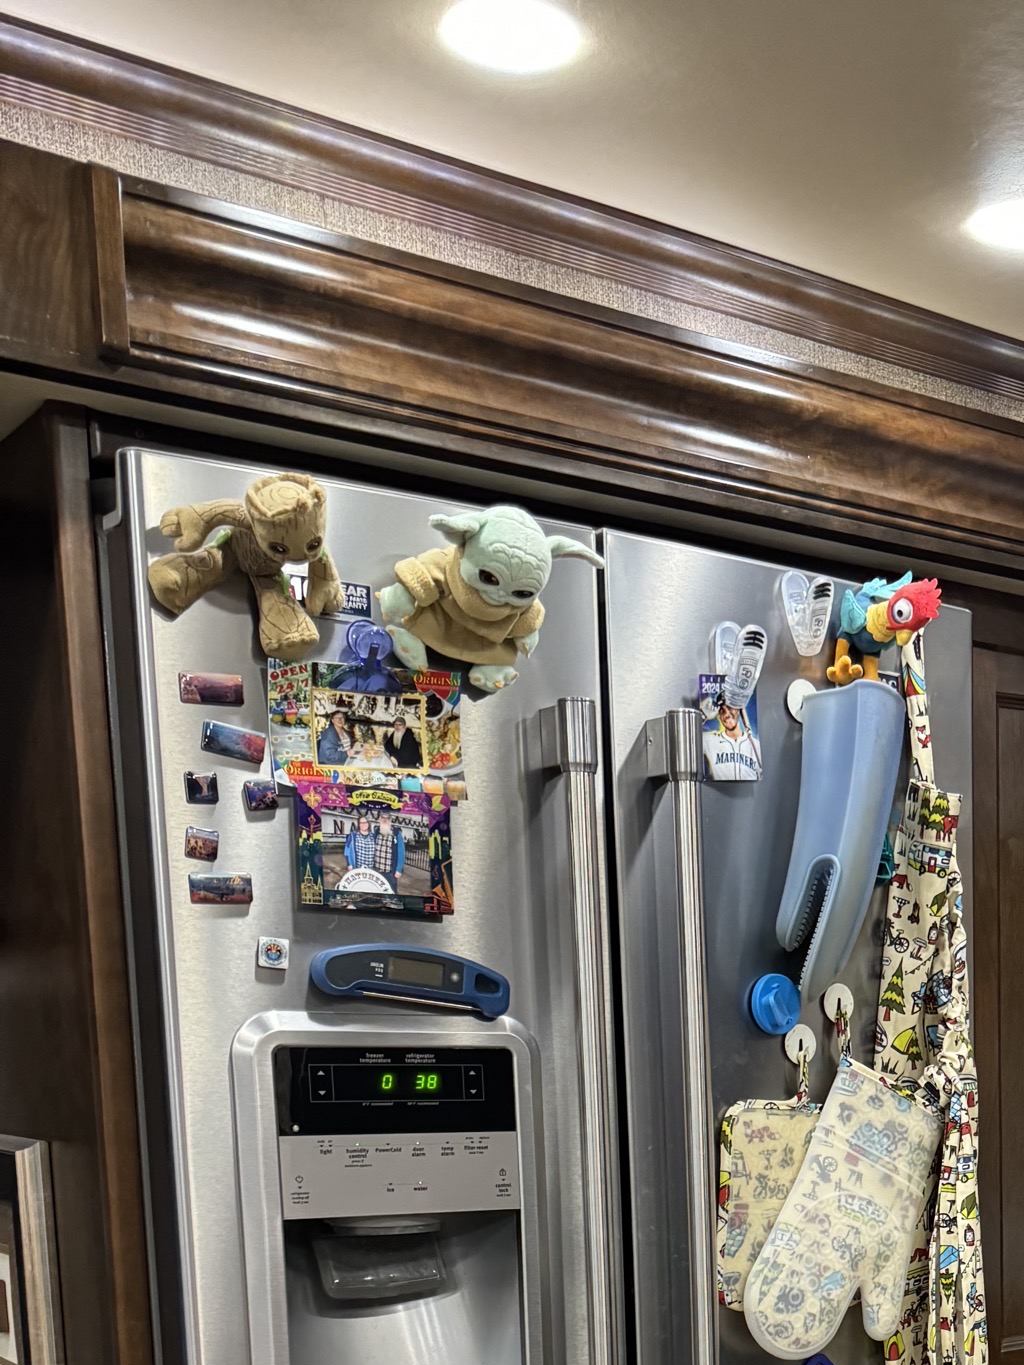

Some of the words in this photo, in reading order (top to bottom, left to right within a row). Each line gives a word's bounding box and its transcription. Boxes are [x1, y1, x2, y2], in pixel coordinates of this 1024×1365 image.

[269, 664, 308, 681] OPEN
[277, 678, 309, 695] 24/7
[701, 682, 720, 694] 2024
[381, 1074, 393, 1090] 0
[415, 1074, 437, 1090] 38
